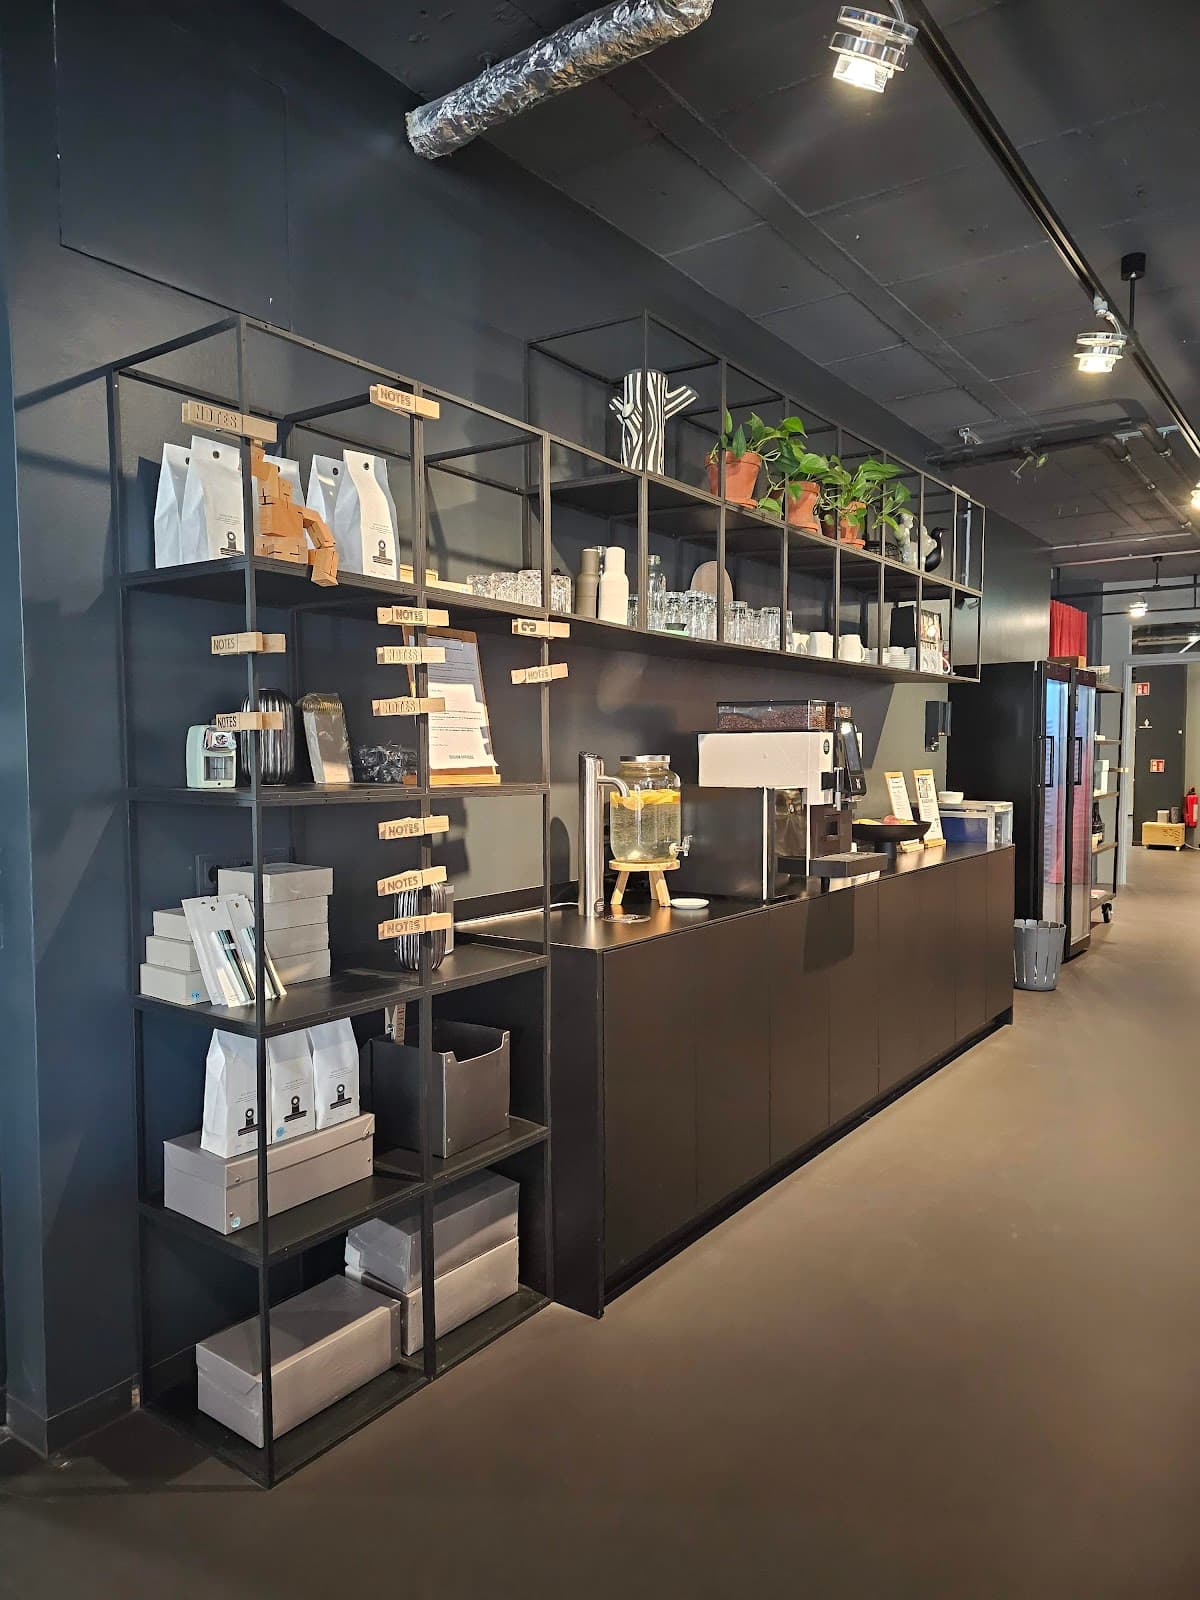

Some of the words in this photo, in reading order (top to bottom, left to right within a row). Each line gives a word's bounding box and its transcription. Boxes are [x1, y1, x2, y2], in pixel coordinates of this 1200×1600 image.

[380, 386, 411, 407] NOTES
[395, 608, 424, 622] NOTES
[212, 638, 235, 651] NOTES
[217, 714, 237, 729] NOTES
[387, 822, 420, 837] NOTES
[387, 876, 419, 891] NOTES
[386, 919, 420, 934] NOTES
